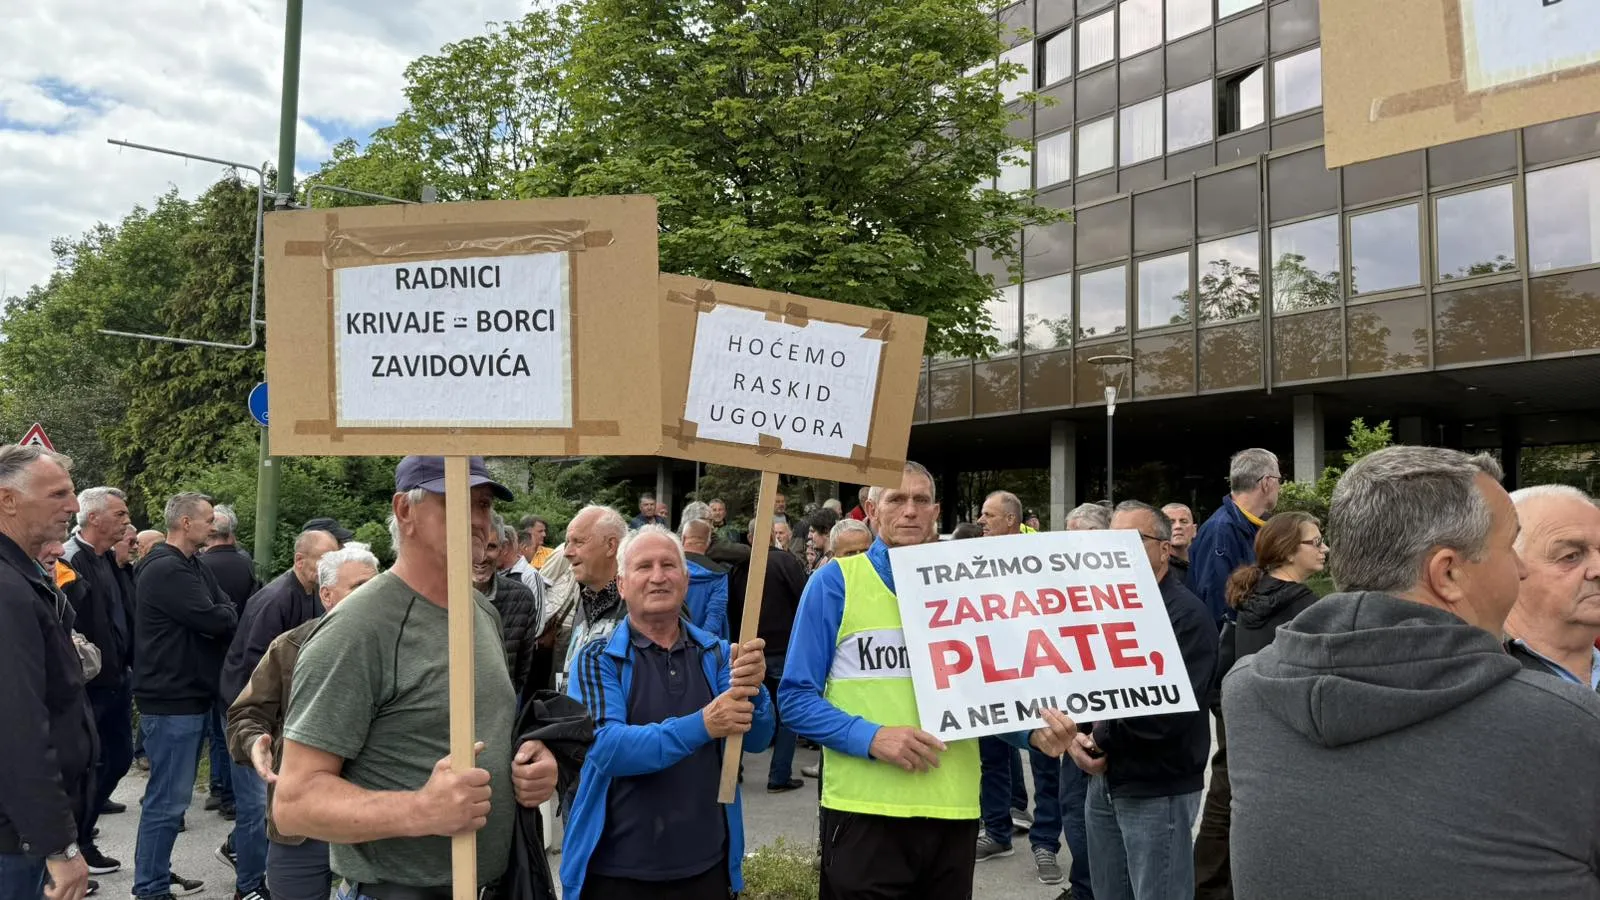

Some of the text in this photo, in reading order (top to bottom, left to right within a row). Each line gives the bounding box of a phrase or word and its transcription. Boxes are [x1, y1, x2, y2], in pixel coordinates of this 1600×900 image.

[396, 265, 500, 290] RADNICI
[347, 311, 445, 334] KRIVAJE
[477, 309, 555, 332] BORCI
[372, 348, 531, 378] ZAVIDOVIĆA
[728, 335, 846, 368] HOĆEMO
[733, 373, 831, 402] RASKID
[710, 405, 843, 438] UGOVORA
[916, 551, 1131, 585] TRAŽIMO SVOJE
[925, 583, 1143, 629] ZARAĐENE
[928, 621, 1165, 690] PLATE,
[940, 710, 961, 732] A
[967, 703, 1008, 727] NE
